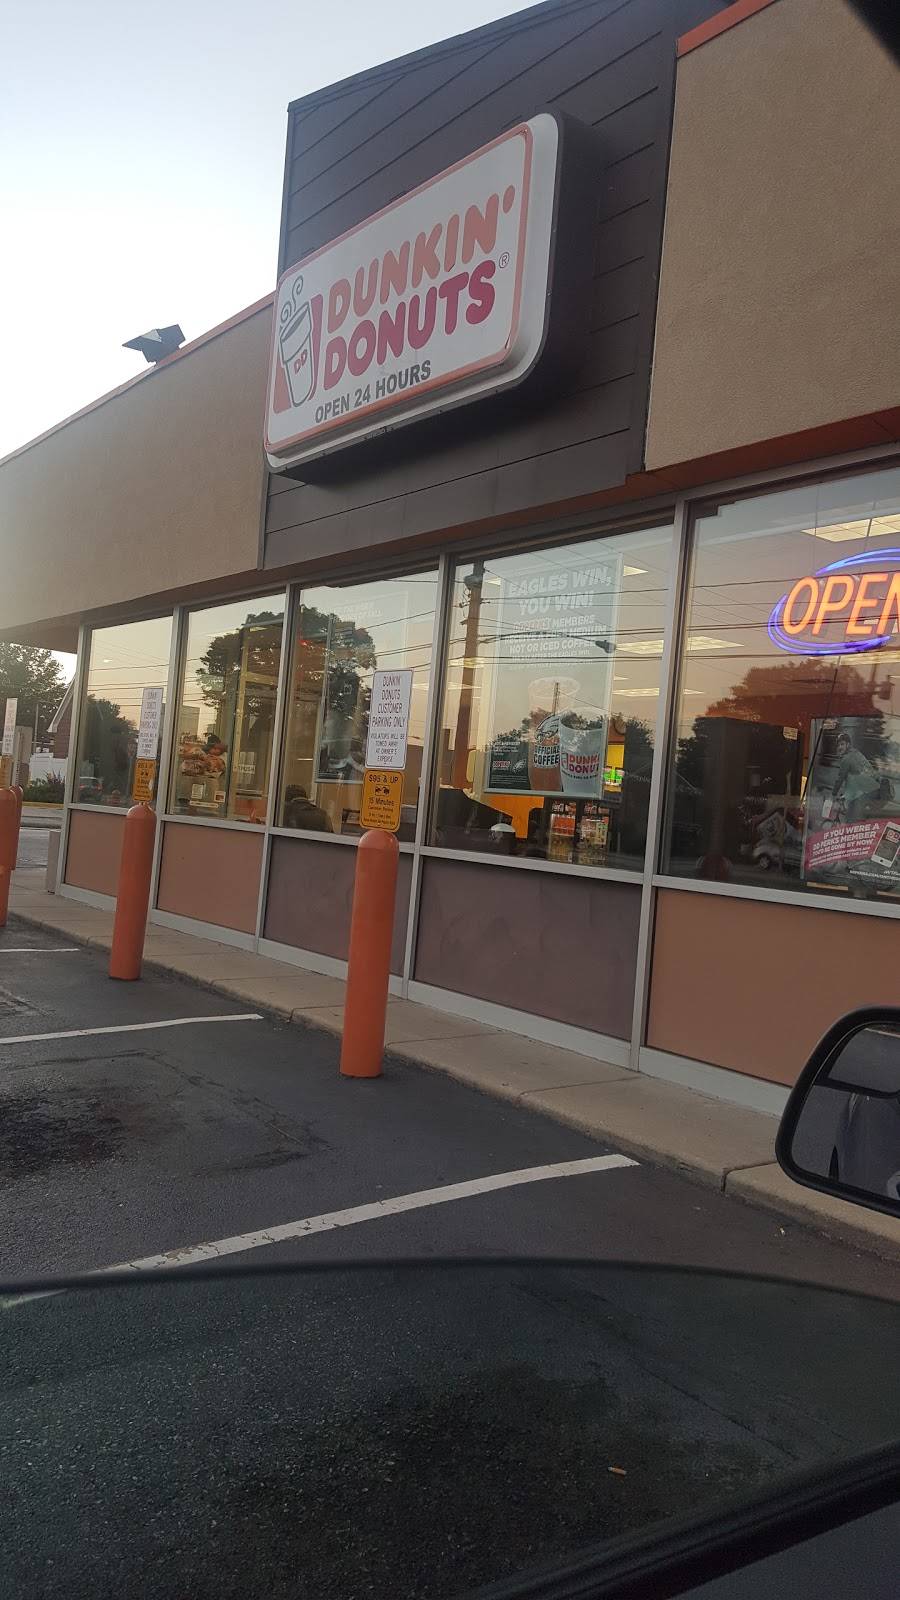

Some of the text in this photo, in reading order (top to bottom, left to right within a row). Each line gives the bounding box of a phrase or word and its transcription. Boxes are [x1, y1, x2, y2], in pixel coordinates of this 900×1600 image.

[326, 184, 516, 334] DUNKIN'
[323, 259, 496, 391] DONUTS
[293, 349, 308, 375] DD
[314, 359, 432, 424] OPEN 24 HOURS
[510, 572, 569, 597] EAGLES
[519, 590, 595, 616] YOU WIN!
[552, 614, 596, 629] MEMBERS
[381, 688, 401, 701] DONUTS
[377, 702, 403, 714] CUSTOMER
[371, 715, 406, 728] PARKING ONLY
[533, 754, 560, 766] COFFEE
[390, 776, 399, 784] UP
[830, 829, 844, 838] YOU
[846, 823, 872, 834] WERE
[872, 823, 880, 831] A
[820, 837, 840, 849] PERKS
[840, 831, 877, 843] MEMBER
[856, 839, 874, 847] NOW
